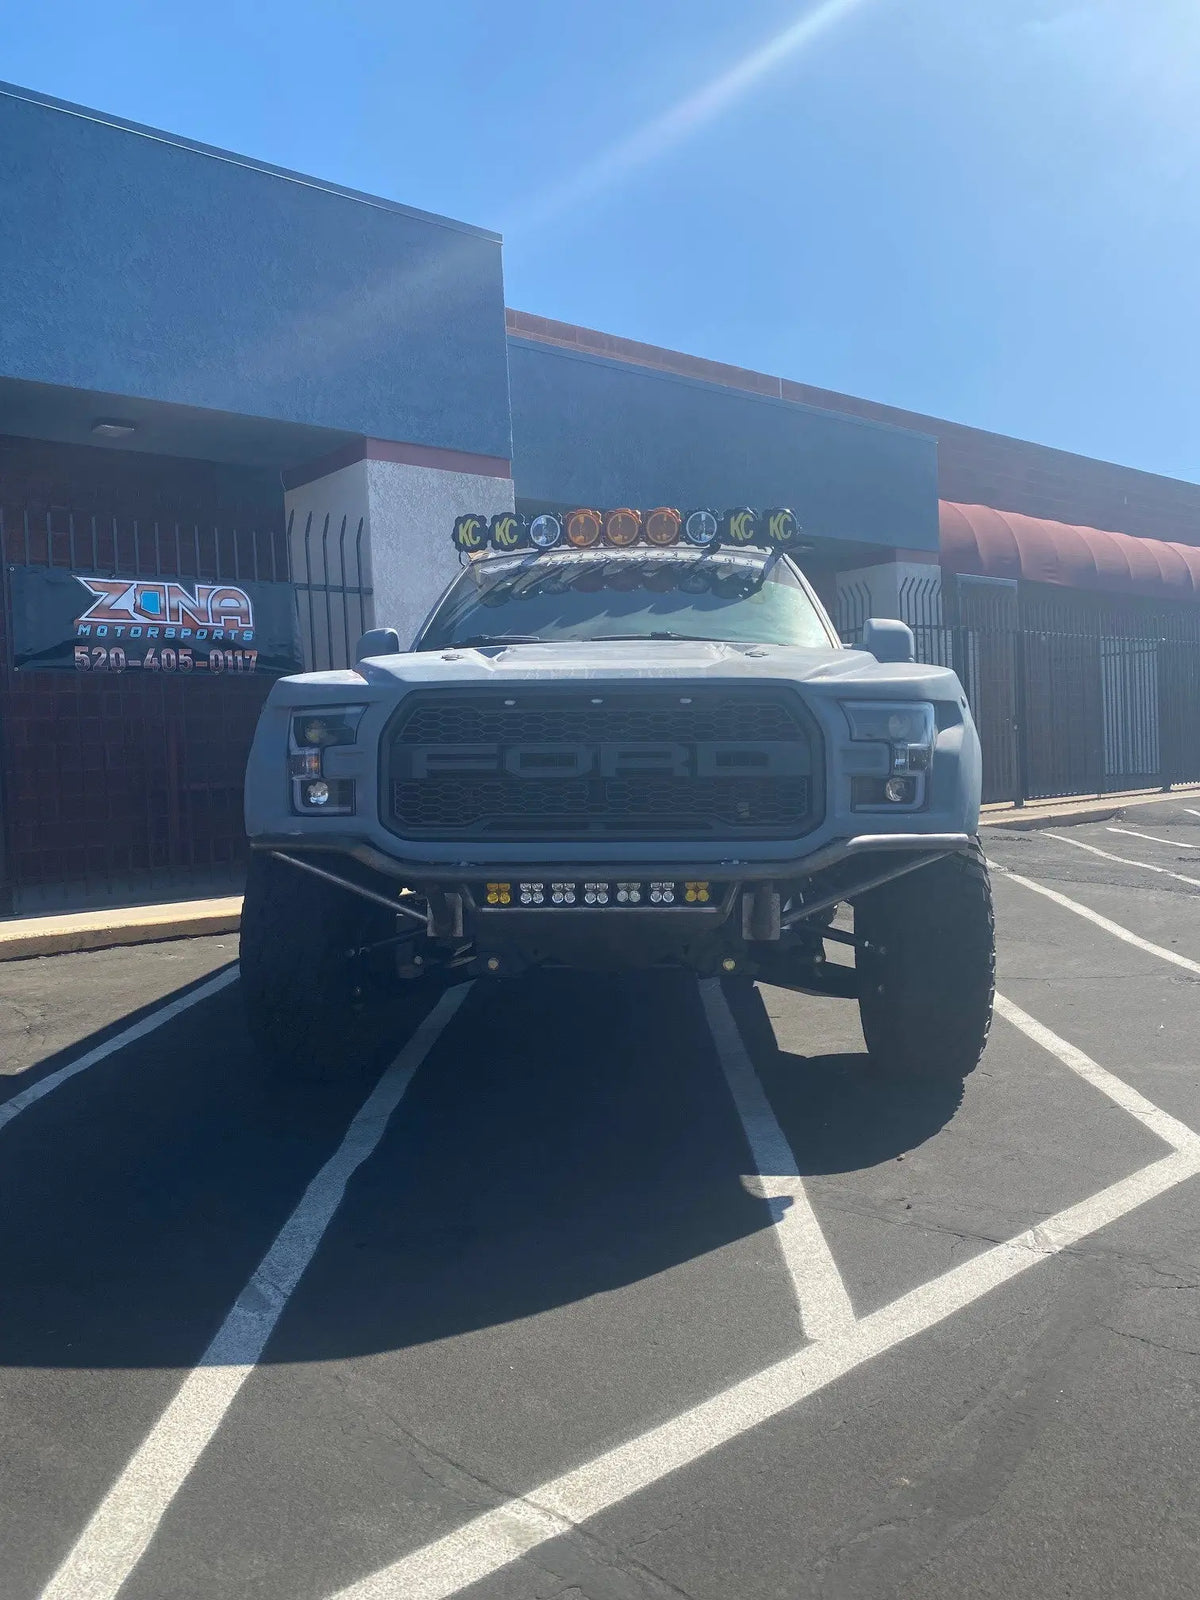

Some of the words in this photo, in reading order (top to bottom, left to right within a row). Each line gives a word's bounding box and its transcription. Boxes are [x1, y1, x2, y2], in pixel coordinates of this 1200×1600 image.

[459, 518, 481, 546] KC
[496, 518, 518, 544] KC
[730, 513, 754, 540] KC
[769, 513, 793, 540] KC
[73, 576, 253, 627] ZONA
[77, 625, 255, 641] MOTORSPORTS
[74, 646, 258, 673] 520-405-0117
[411, 742, 797, 779] FORD
